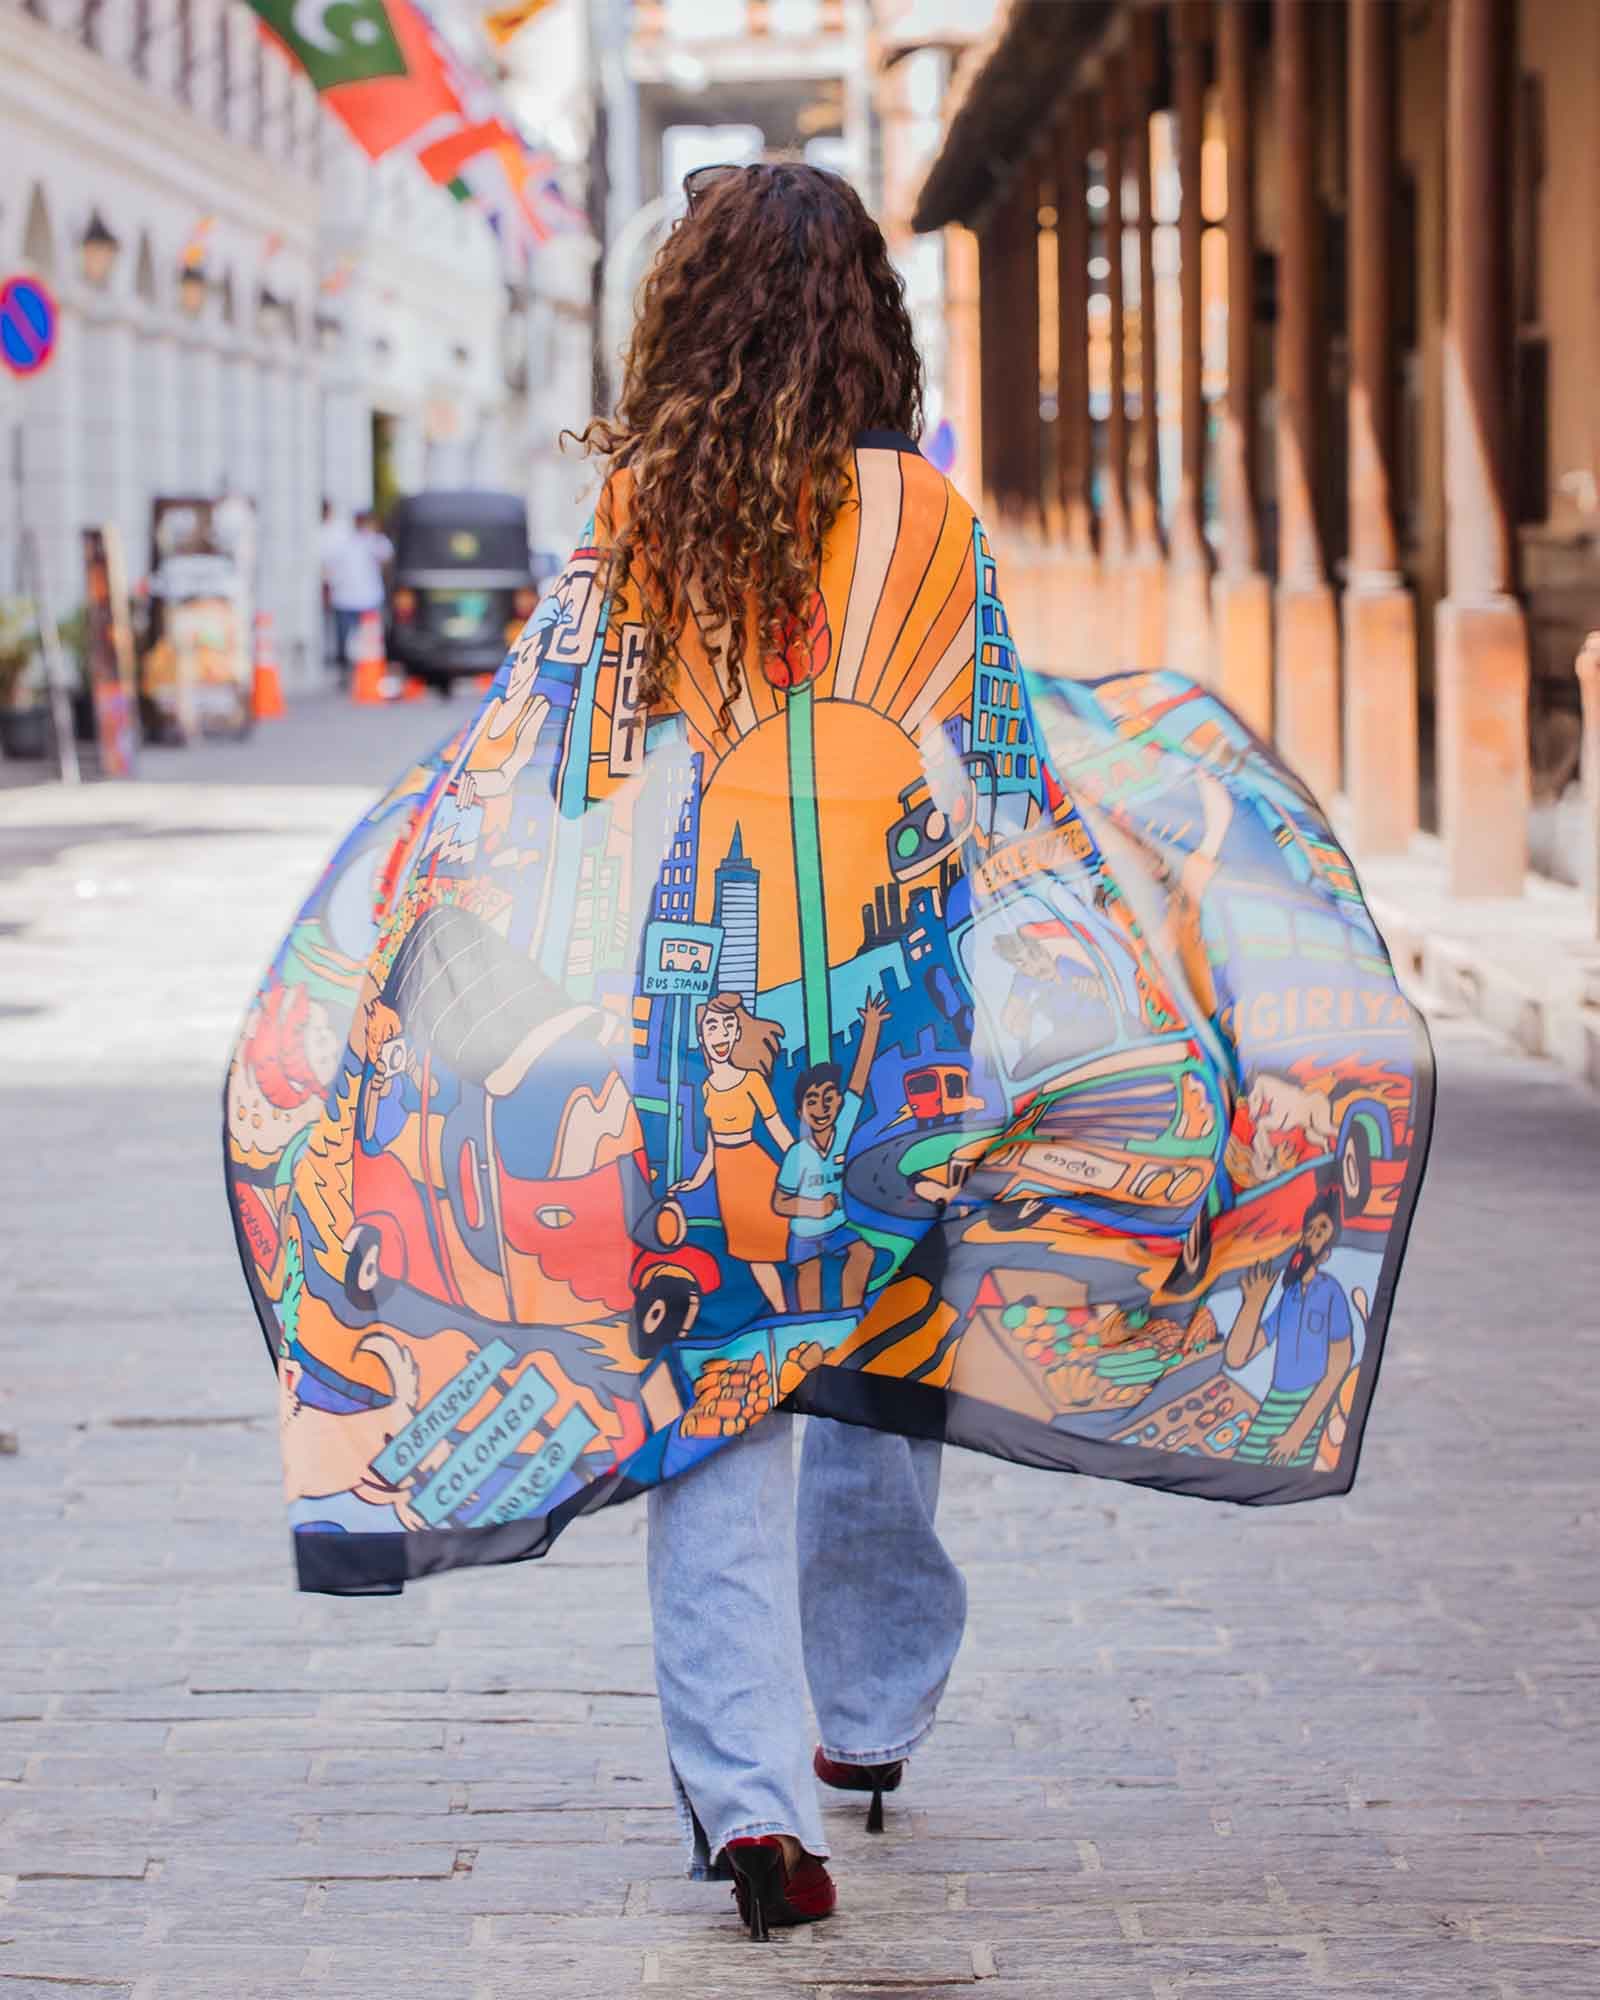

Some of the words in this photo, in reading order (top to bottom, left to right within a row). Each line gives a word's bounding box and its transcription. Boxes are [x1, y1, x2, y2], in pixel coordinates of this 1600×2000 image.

[647, 976, 668, 990] BUS
[673, 977, 709, 992] STAND
[435, 1393, 535, 1506] COLOMBO
